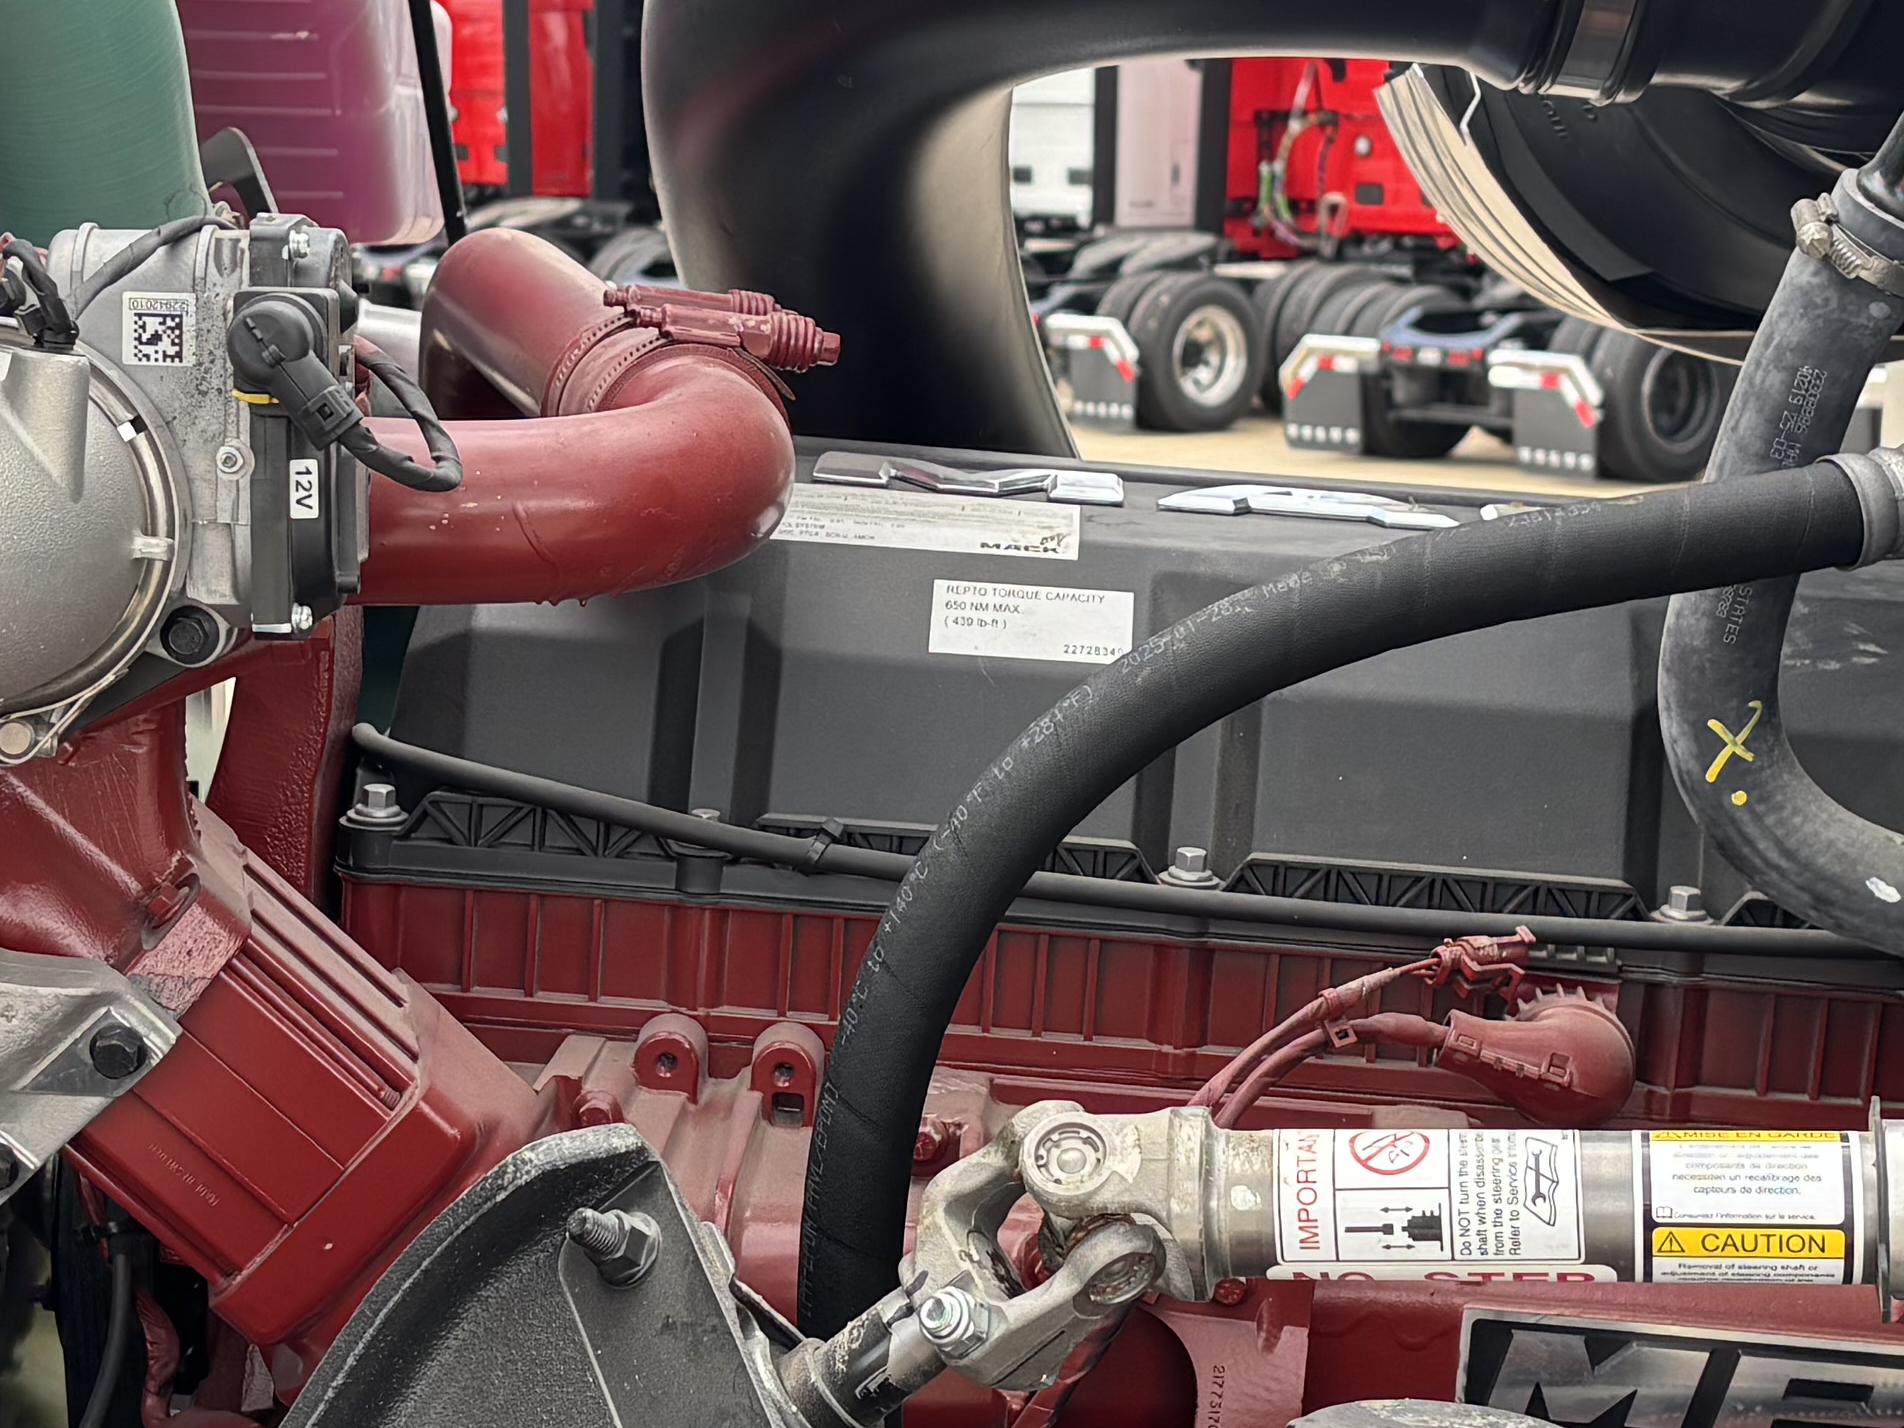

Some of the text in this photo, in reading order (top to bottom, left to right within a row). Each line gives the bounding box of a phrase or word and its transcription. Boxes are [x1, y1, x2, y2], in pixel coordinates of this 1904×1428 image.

[294, 465, 313, 510] 12V
[970, 601, 989, 613] NM
[992, 587, 1041, 601] TORQUE
[1046, 590, 1105, 604] CAPACITY
[1723, 585, 1752, 644] STATES
[1736, 1131, 1761, 1139] EN
[1458, 1160, 1469, 1177] the
[1296, 1131, 1321, 1250] IMPORTAN
[1458, 1180, 1470, 1205] turn
[1507, 1161, 1519, 1205] Service
[1490, 1157, 1504, 1256] from the steering
[1508, 1209, 1520, 1221] to
[1458, 1208, 1471, 1238] NOT
[1475, 1192, 1489, 1256] shaft when
[1459, 1241, 1472, 1256] Do
[1508, 1225, 1522, 1256] Refer
[1701, 1233, 1826, 1254] CAUTION
